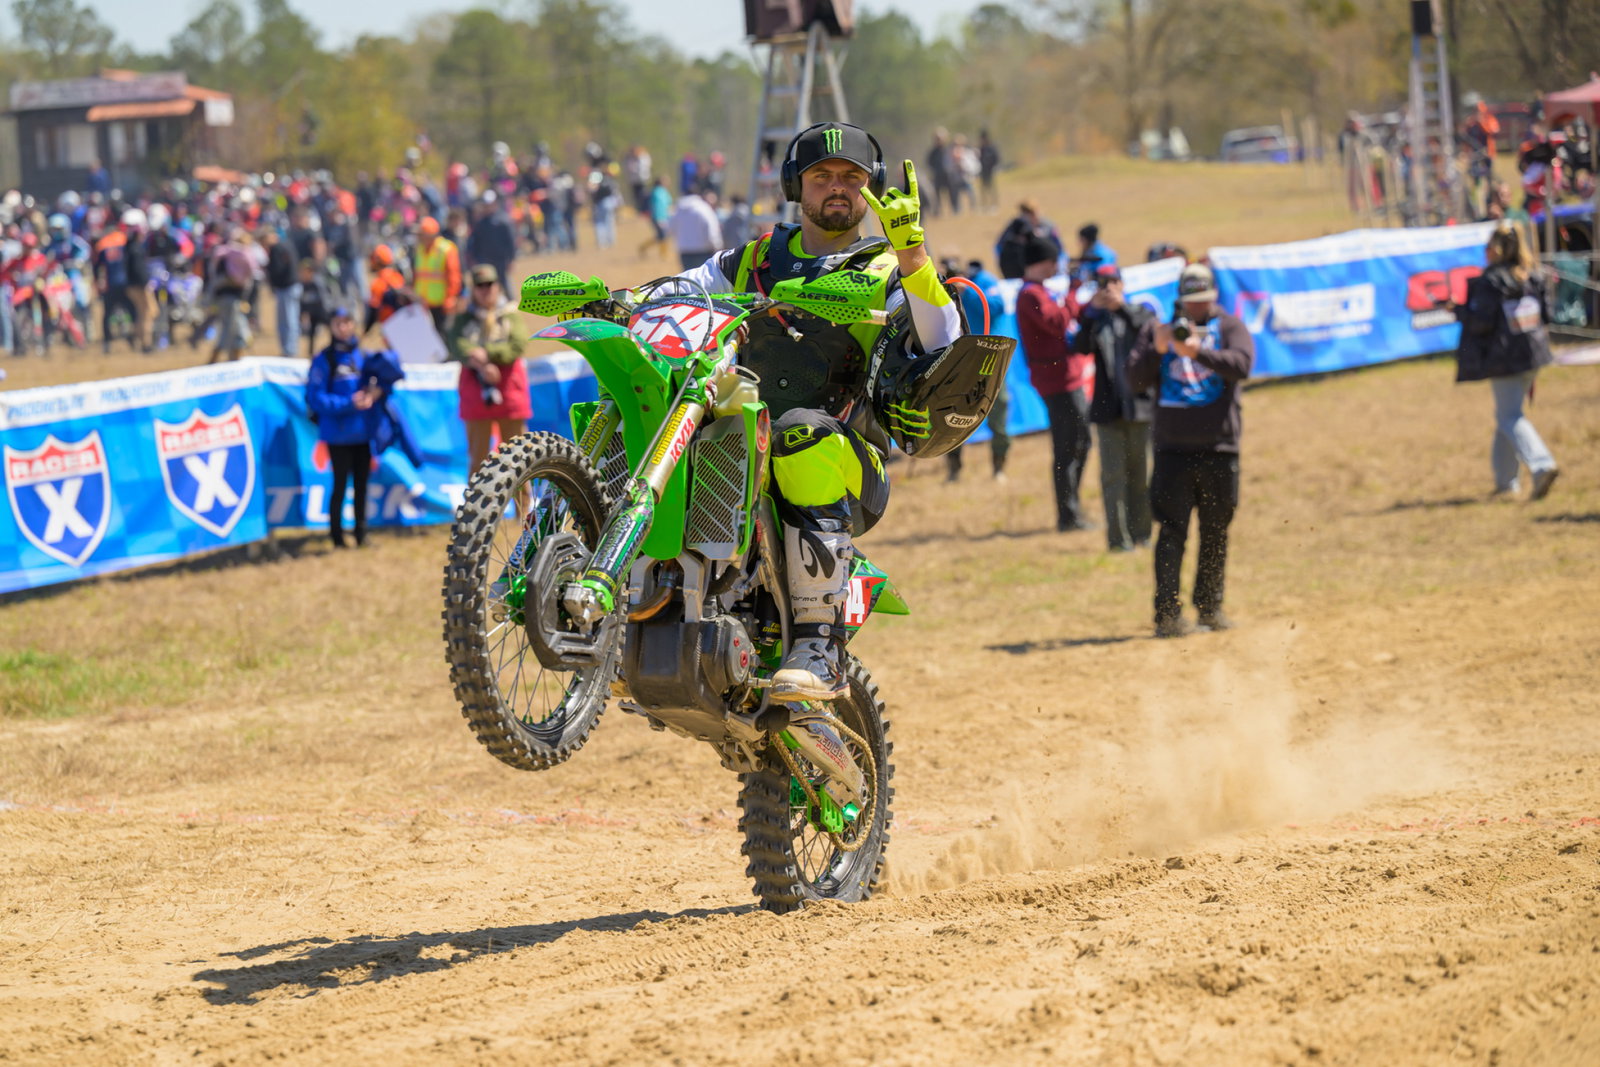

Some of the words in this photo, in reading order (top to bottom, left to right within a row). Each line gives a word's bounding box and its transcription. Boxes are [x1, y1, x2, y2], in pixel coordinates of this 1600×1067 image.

[890, 211, 919, 229] MSR
[841, 271, 880, 287] ASV
[162, 421, 241, 455] RACER
[670, 417, 696, 464] KYB
[10, 448, 97, 480] RACER
[183, 449, 240, 513] X
[35, 477, 94, 544] X
